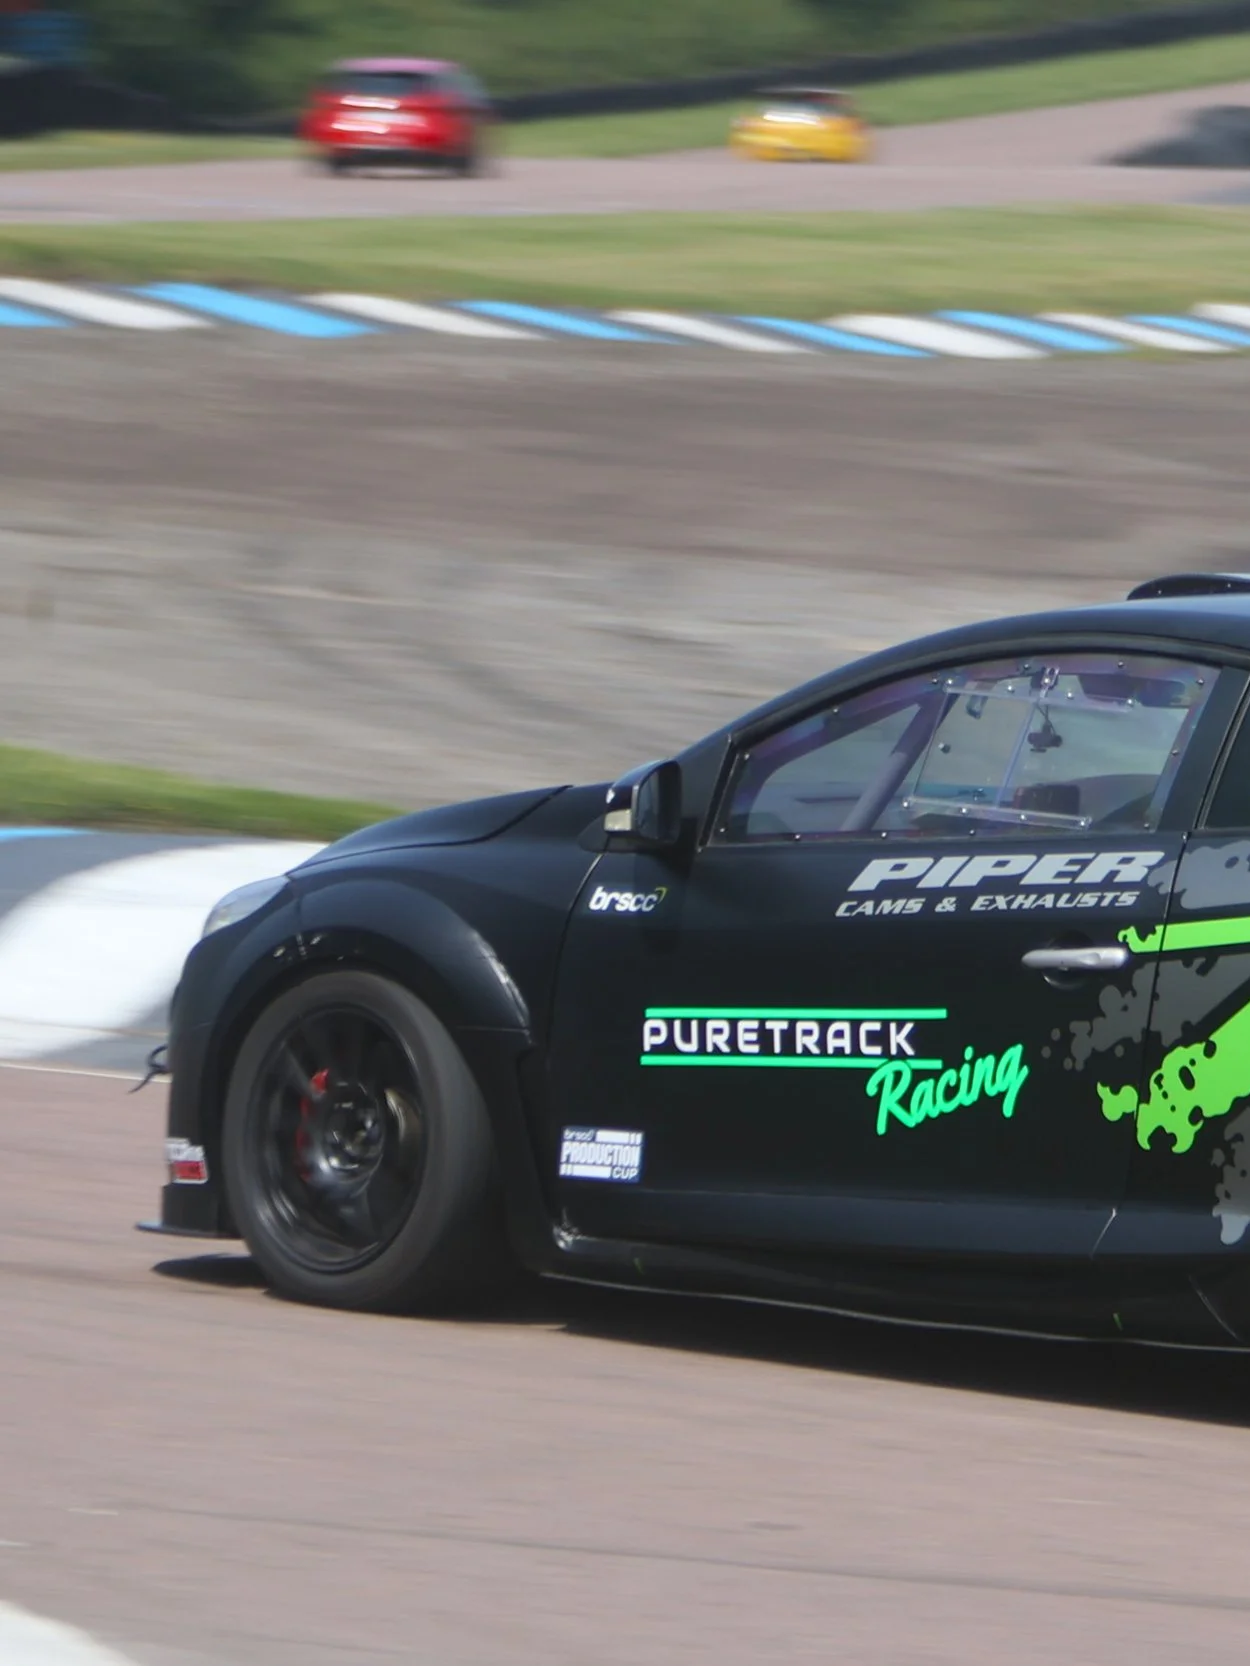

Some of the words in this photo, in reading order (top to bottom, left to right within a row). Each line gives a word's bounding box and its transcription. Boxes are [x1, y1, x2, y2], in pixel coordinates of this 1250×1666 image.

[847, 851, 1165, 892] PIPER
[588, 885, 659, 912] brscc
[835, 897, 926, 917] CAMS
[935, 896, 957, 913] &
[970, 891, 1140, 911] EXHAUSTS
[642, 1020, 916, 1056] PURETRACK
[866, 1044, 1028, 1136] Racing
[560, 1141, 641, 1168] PRODUCTION
[612, 1166, 640, 1180] CUP
